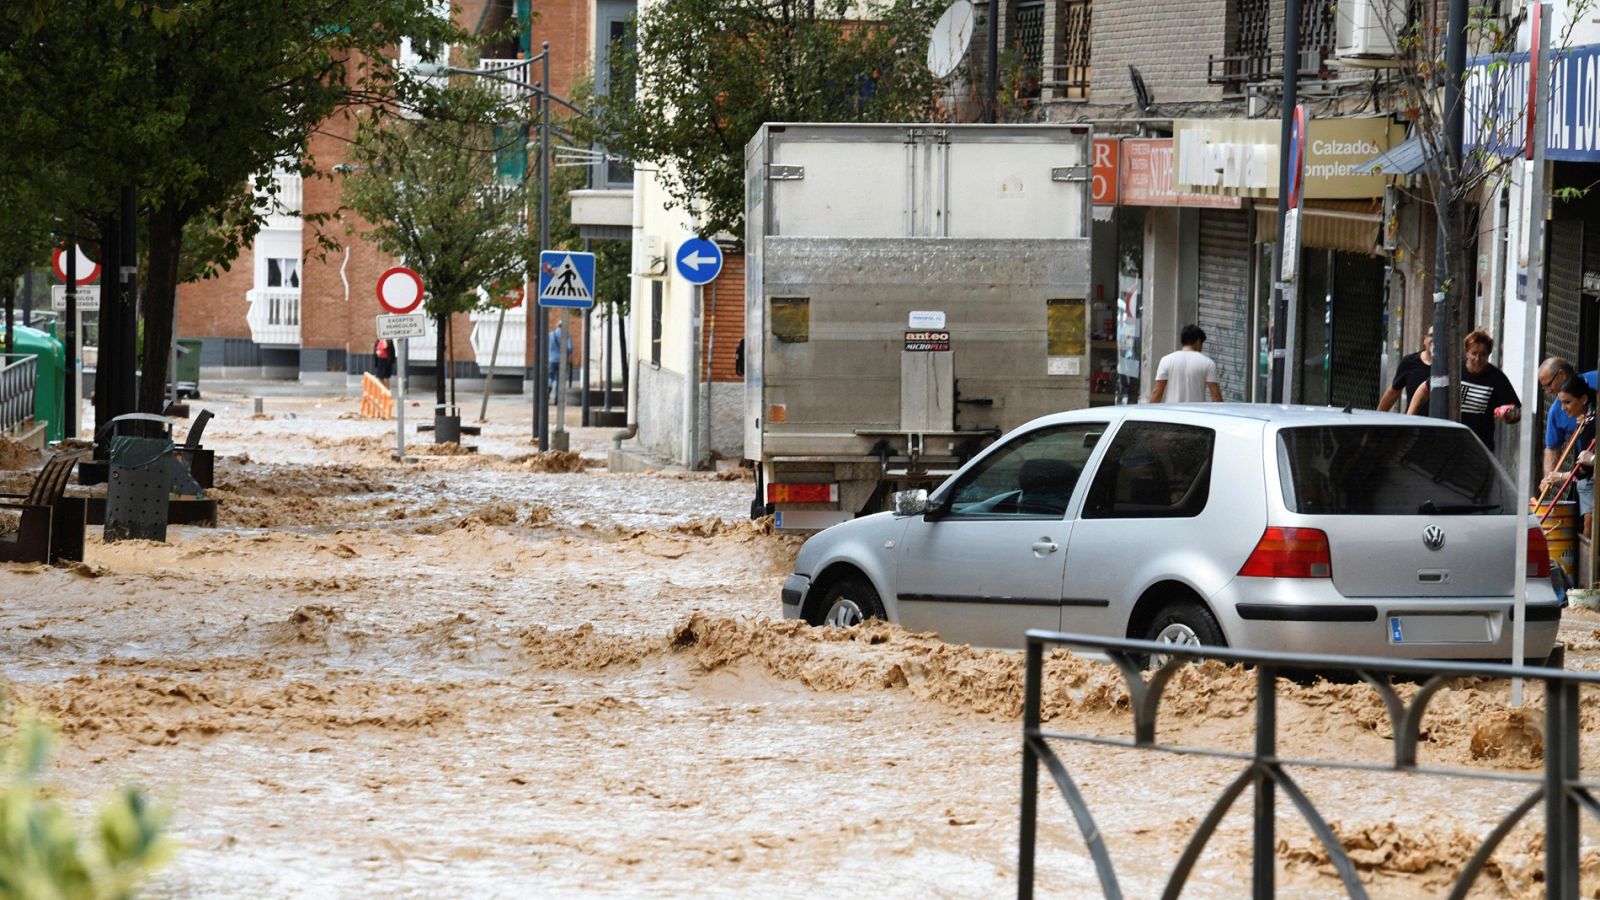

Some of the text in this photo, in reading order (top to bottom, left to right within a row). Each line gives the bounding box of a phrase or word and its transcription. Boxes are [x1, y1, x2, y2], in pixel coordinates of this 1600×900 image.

[1312, 139, 1379, 155] Calzados
[382, 328, 422, 336] AUTORIZAS
[905, 332, 949, 340] anteo
